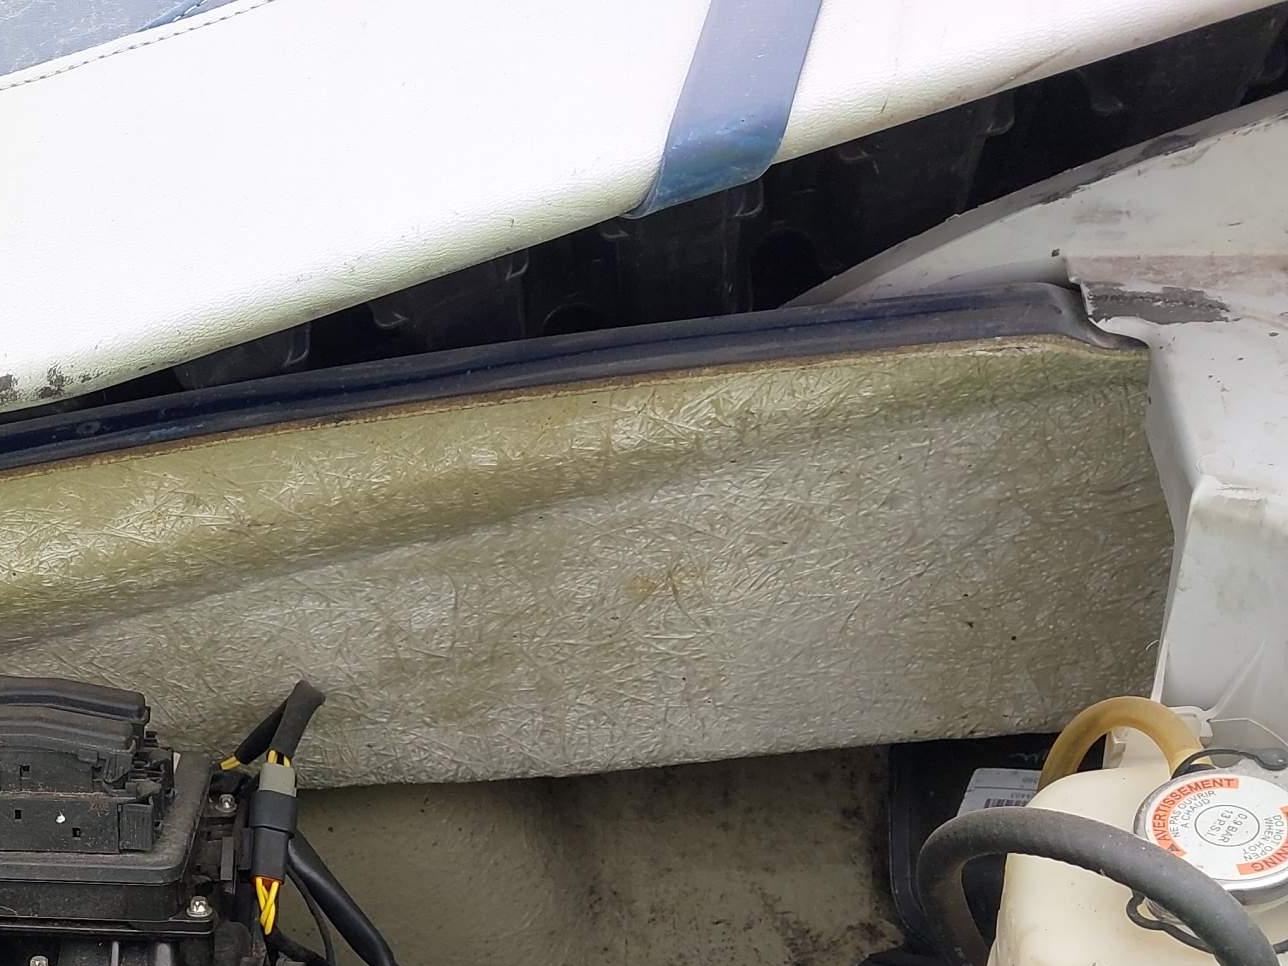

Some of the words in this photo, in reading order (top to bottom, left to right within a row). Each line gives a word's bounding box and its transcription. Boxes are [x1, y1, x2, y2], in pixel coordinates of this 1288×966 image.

[1178, 790, 1217, 811] OUVRIR
[1153, 778, 1235, 841] AVERTISSEMENT
[1170, 809, 1182, 826] PAS
[1181, 798, 1211, 822] CHAUD
[1219, 809, 1234, 819] 13
[1272, 814, 1285, 827] DO
[1169, 826, 1179, 838] NE
[1218, 825, 1239, 844] BAR
[1261, 816, 1274, 842] WHEN
[1272, 829, 1285, 845] NOT
[1242, 840, 1265, 856] HOT
[1244, 846, 1272, 861] OPEN
